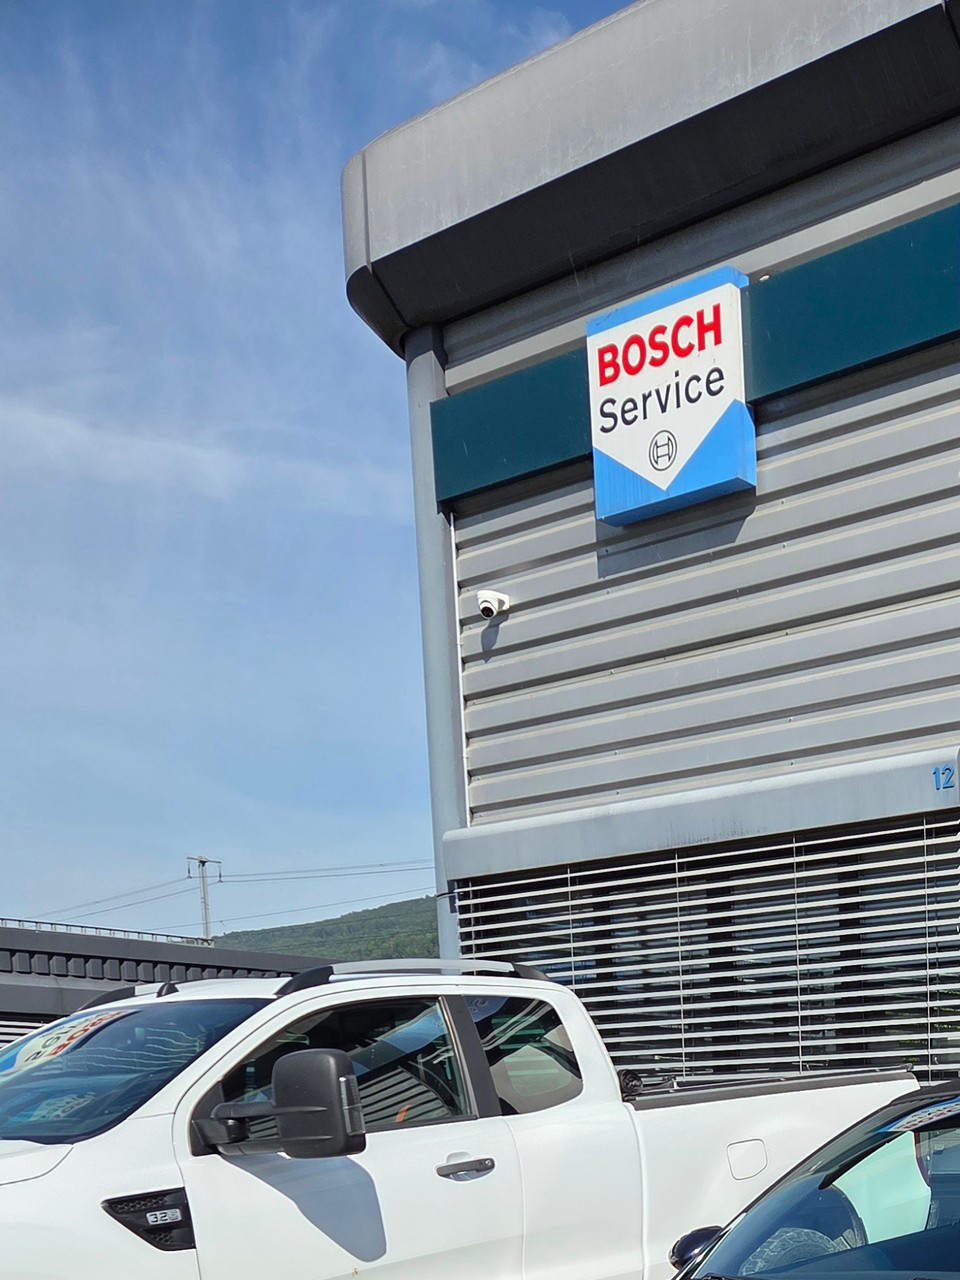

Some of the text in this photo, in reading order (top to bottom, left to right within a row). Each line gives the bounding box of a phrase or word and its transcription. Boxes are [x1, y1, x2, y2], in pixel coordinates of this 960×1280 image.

[597, 302, 722, 387] BOSCH
[599, 366, 725, 434] Service
[932, 763, 956, 791] 12
